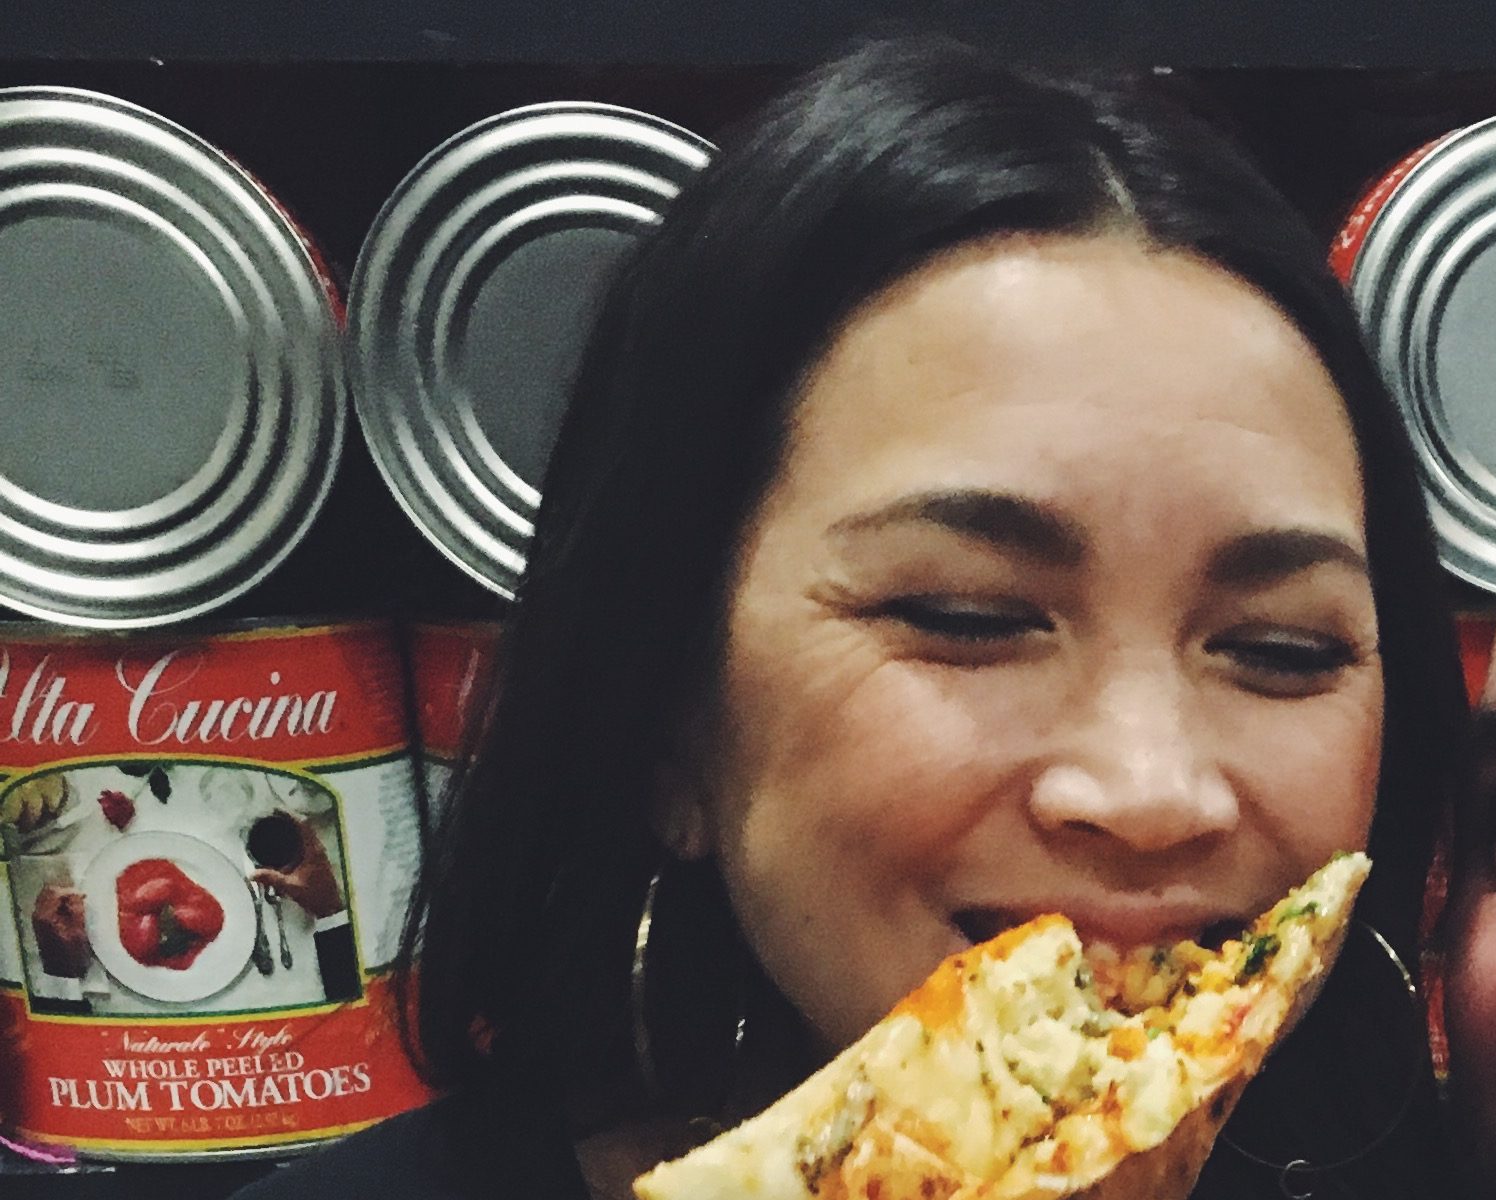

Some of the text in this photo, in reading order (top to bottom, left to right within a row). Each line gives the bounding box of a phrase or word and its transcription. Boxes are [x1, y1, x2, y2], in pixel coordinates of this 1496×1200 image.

[115, 650, 337, 745] Cucina
[48, 1063, 371, 1112] PLUM TOMATOES
[102, 1050, 304, 1081] WHOLE PEELED
